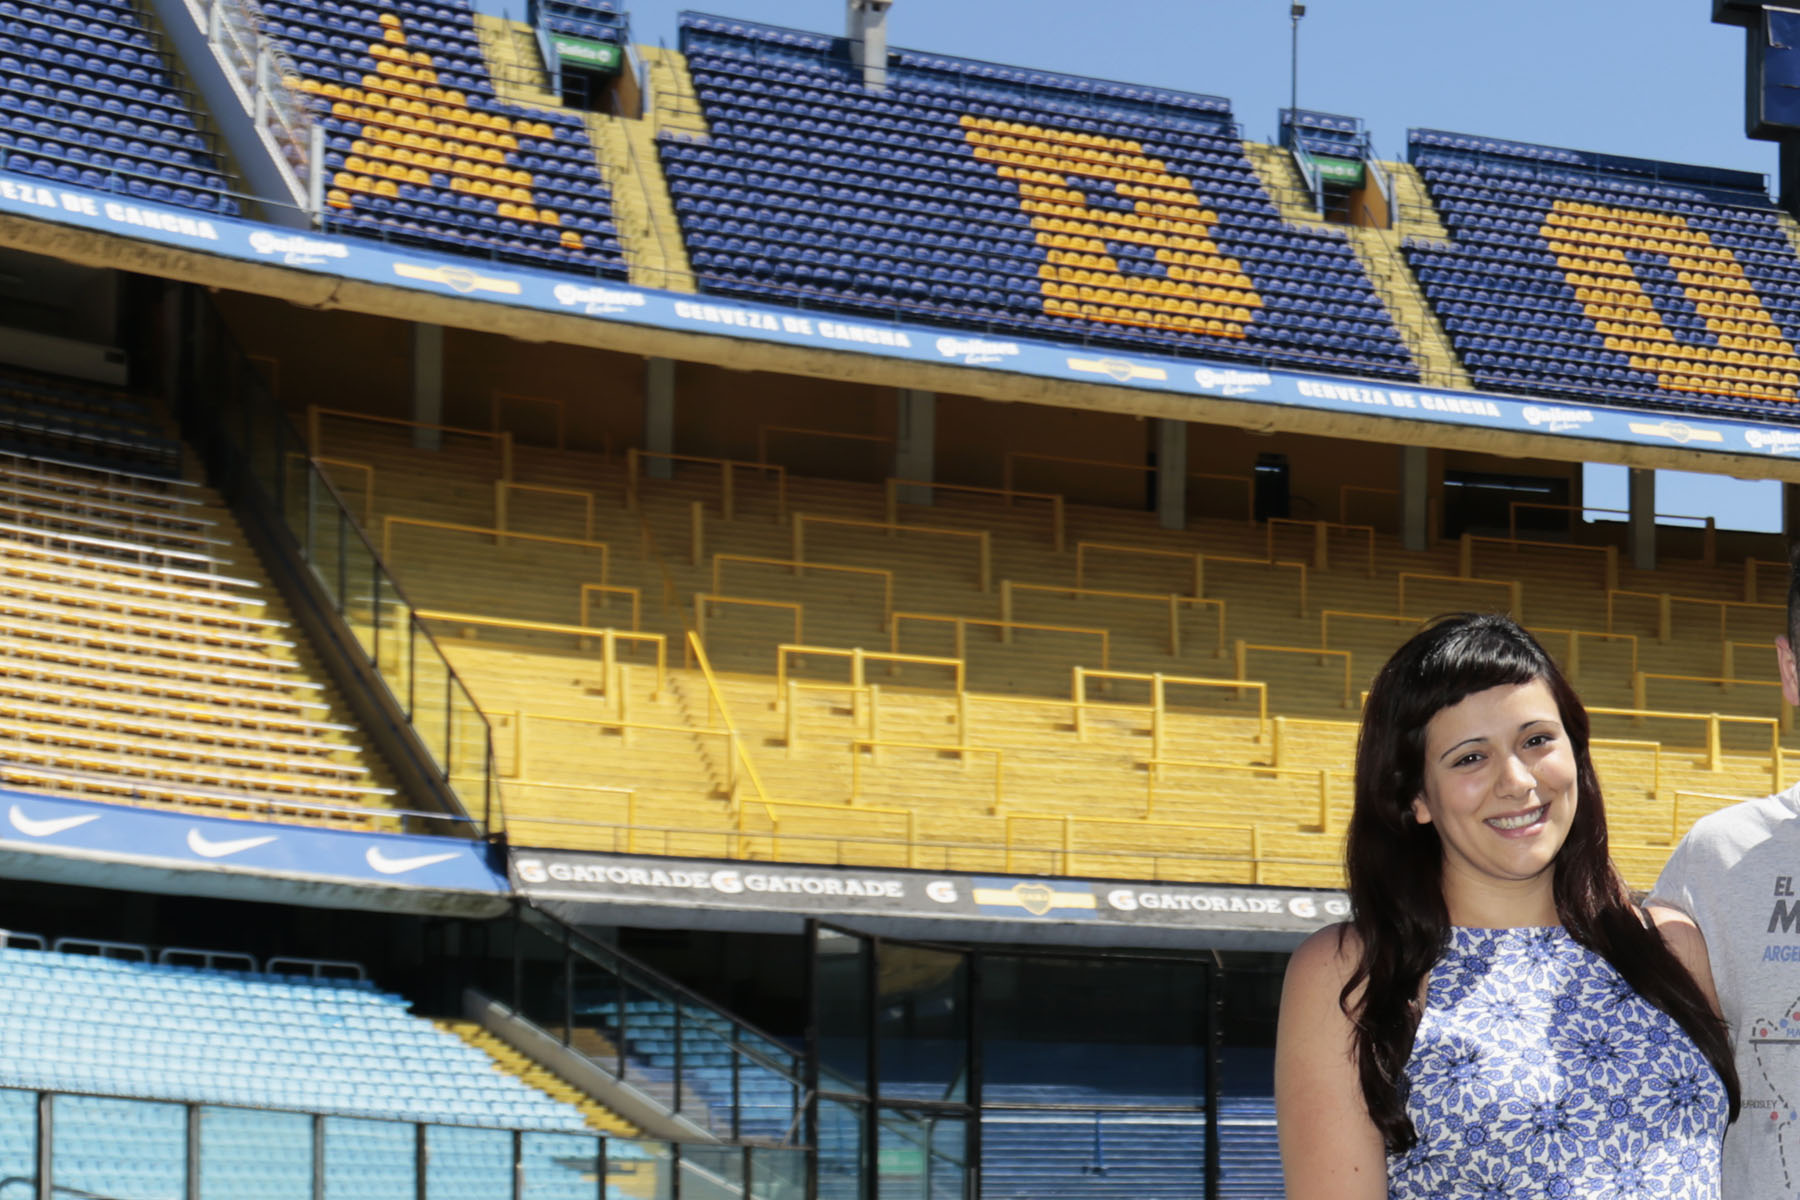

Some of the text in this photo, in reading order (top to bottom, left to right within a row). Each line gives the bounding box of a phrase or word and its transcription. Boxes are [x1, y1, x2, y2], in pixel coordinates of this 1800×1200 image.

[60, 192, 99, 217] DE
[104, 202, 219, 240] CANCHA
[675, 302, 912, 348] CERVEZA DE CANCHA
[1297, 380, 1501, 417] CERVEZA DE CANCHA
[548, 862, 711, 889] GATORADE
[711, 870, 743, 894] G
[744, 873, 903, 898] GATORADE
[926, 881, 957, 903] G
[1773, 876, 1795, 897] EL
[1107, 889, 1138, 910] G
[1138, 893, 1283, 914] GATORADE
[1289, 898, 1317, 918] G
